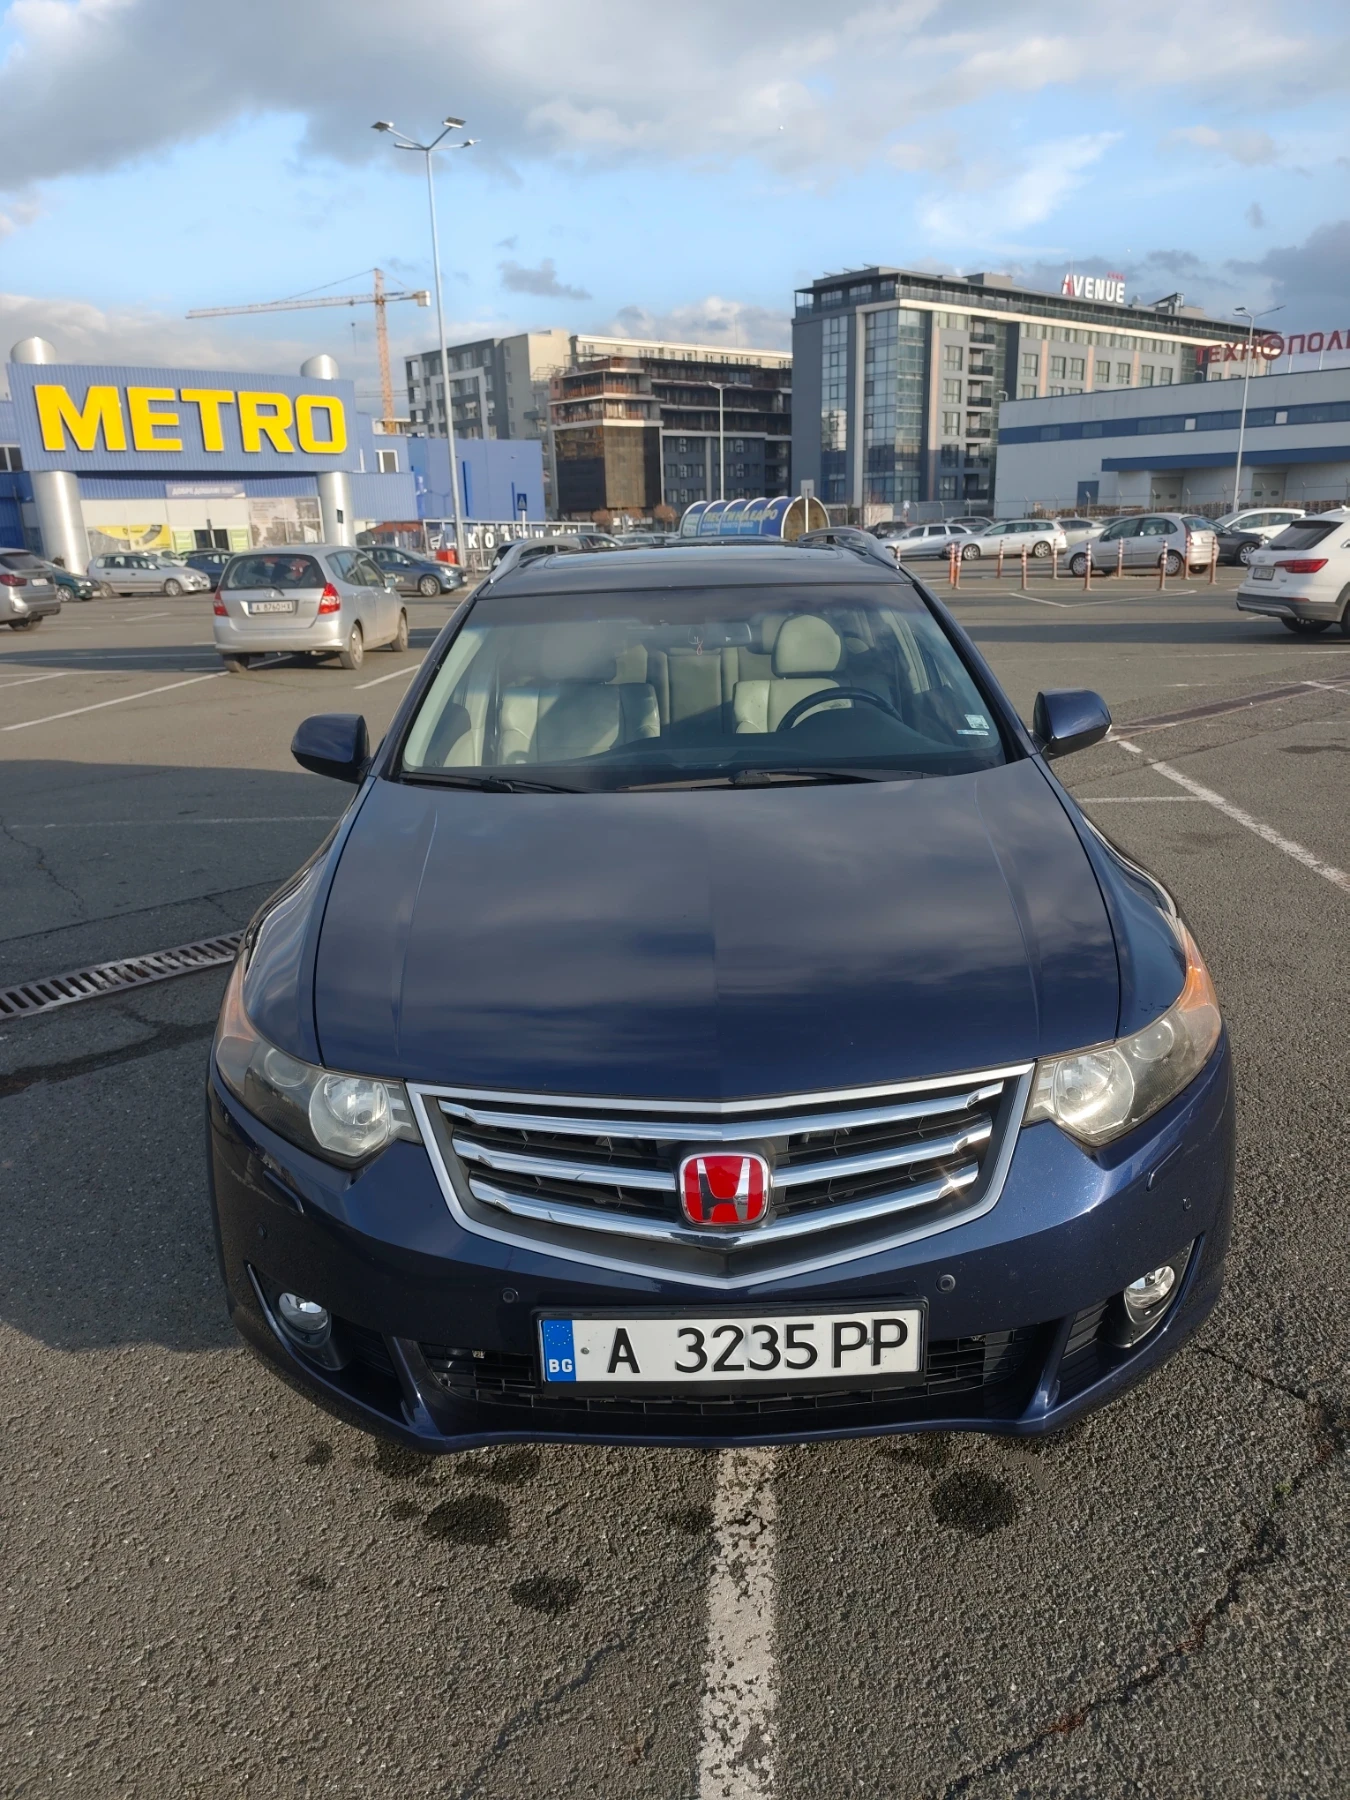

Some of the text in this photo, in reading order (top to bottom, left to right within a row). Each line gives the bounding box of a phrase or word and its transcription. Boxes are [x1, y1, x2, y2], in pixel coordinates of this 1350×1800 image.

[1062, 273, 1126, 304] AVENUE
[1195, 329, 1350, 365] ТЕХНОПОЛ
[35, 385, 347, 453] METRO
[549, 1358, 573, 1373] BG
[607, 1328, 640, 1373] A
[676, 1323, 818, 1373] 3235
